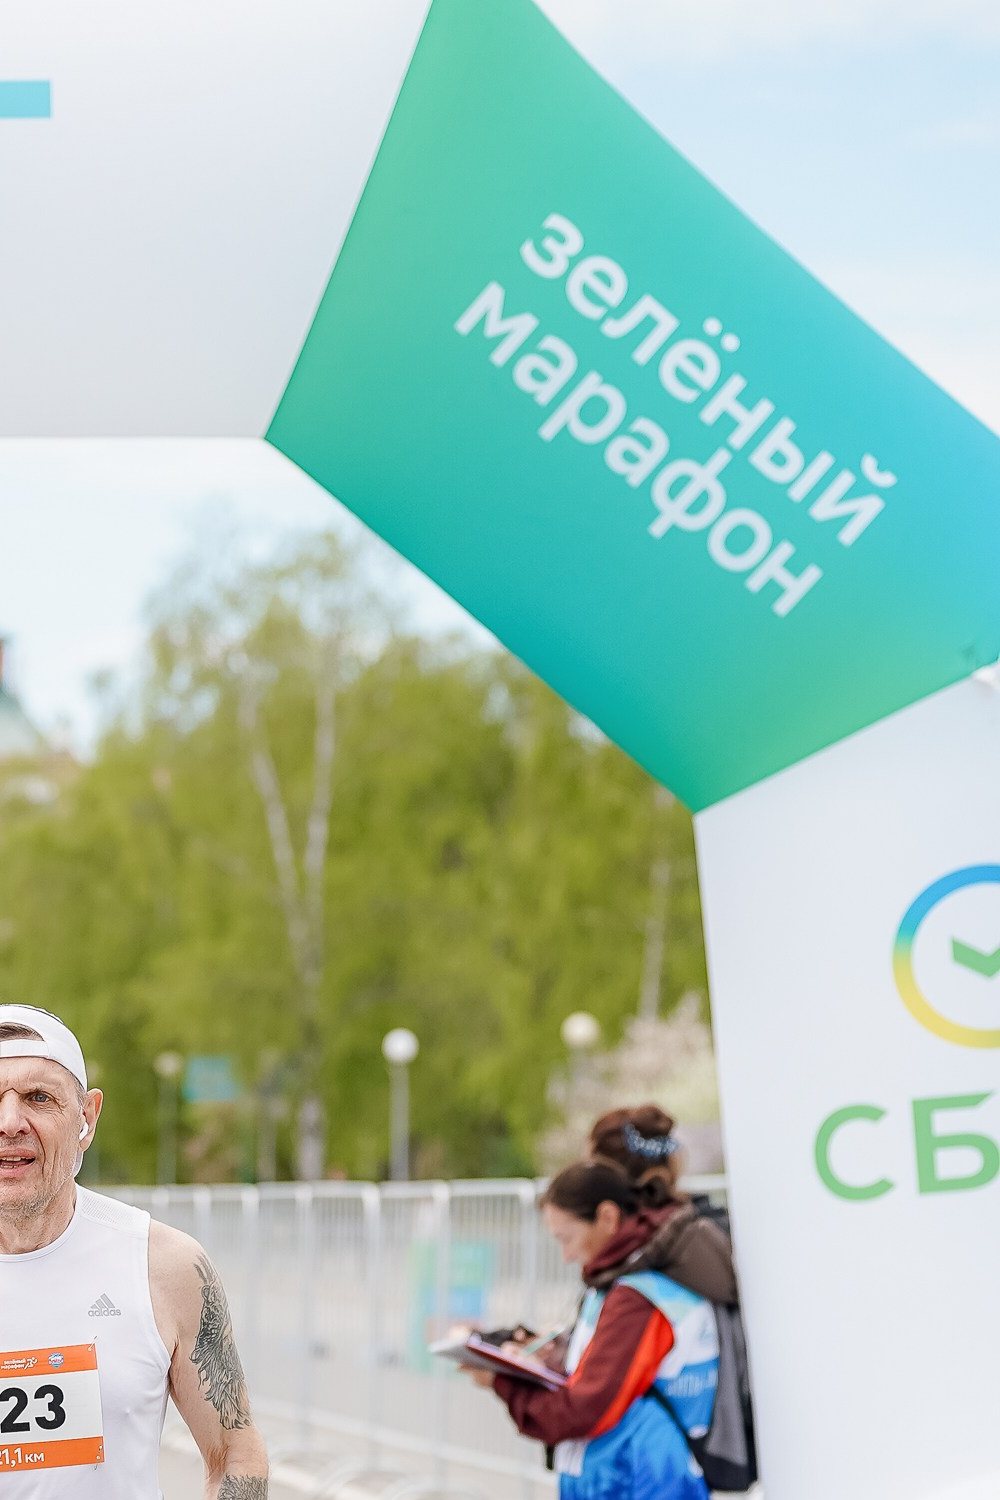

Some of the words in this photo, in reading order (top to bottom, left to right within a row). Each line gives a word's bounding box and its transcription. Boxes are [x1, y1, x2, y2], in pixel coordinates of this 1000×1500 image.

[453, 280, 824, 618] марафон
[519, 212, 898, 548] зелёный
[87, 1308, 122, 1317] adidas
